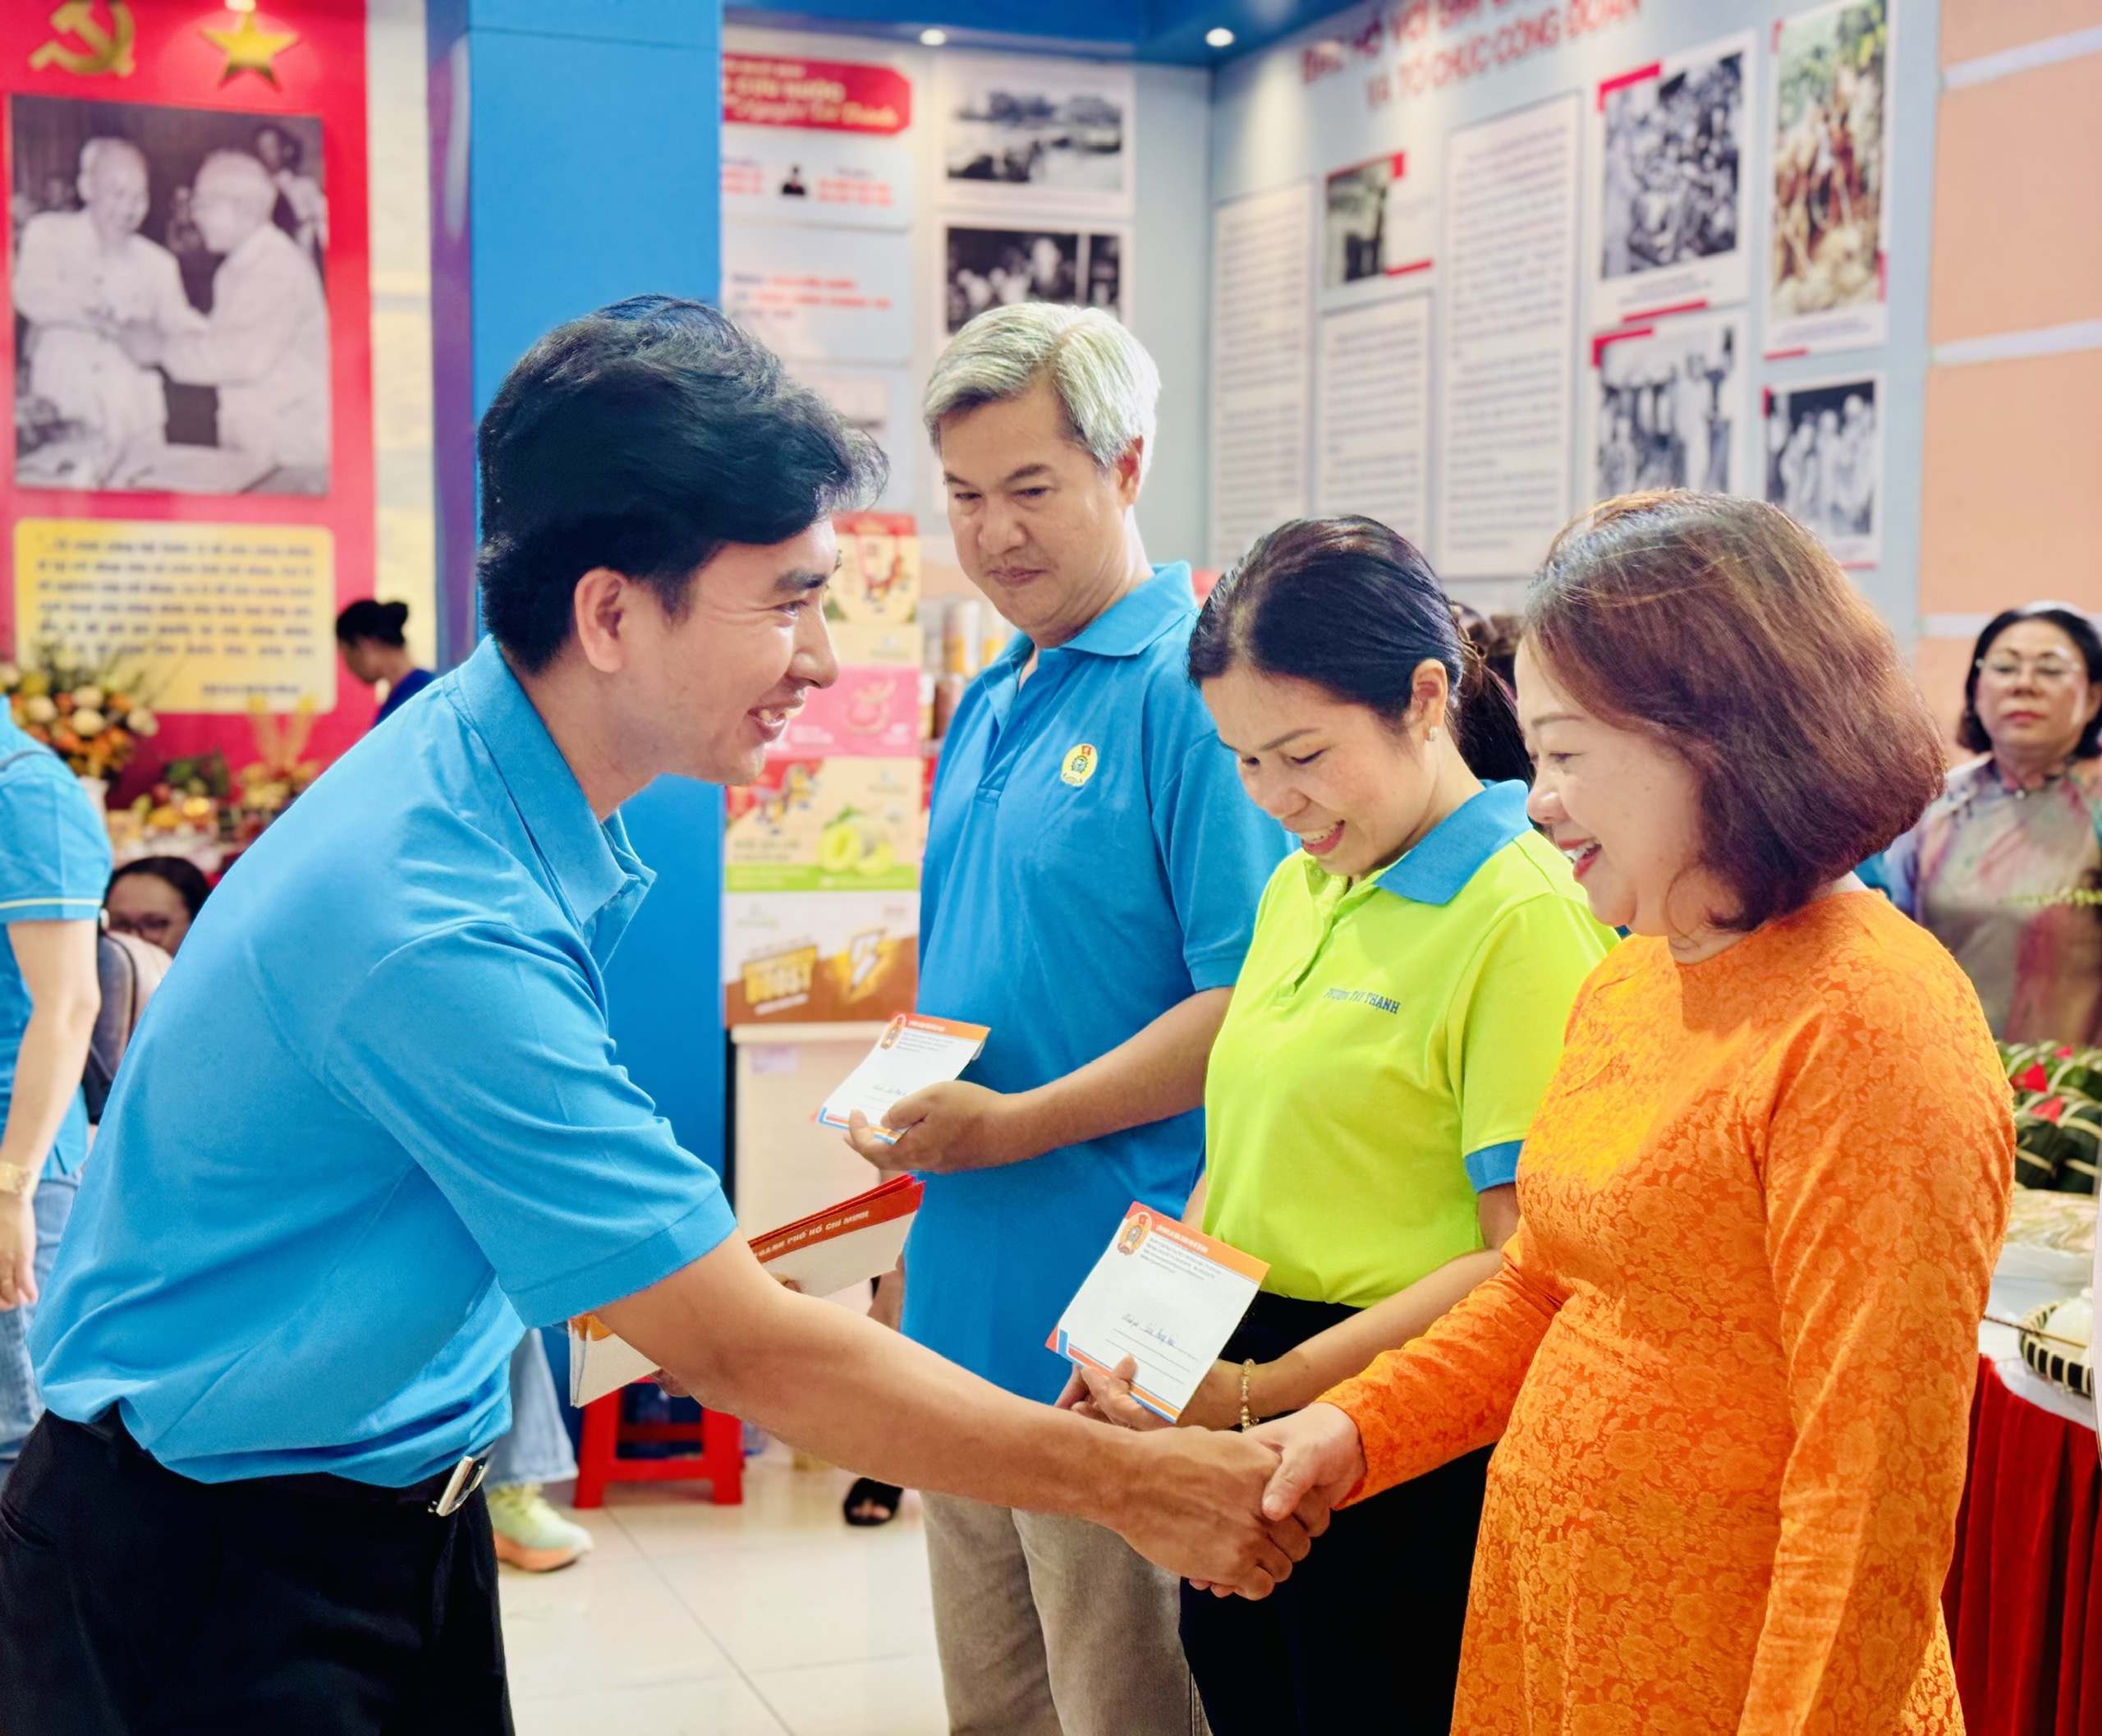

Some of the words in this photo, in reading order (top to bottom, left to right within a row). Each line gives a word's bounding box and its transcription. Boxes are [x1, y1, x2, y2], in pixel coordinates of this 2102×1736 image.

[787, 1229, 807, 1244] PHỐ
[824, 1219, 842, 1231] CHÍ
[843, 1210, 869, 1224] MINH
